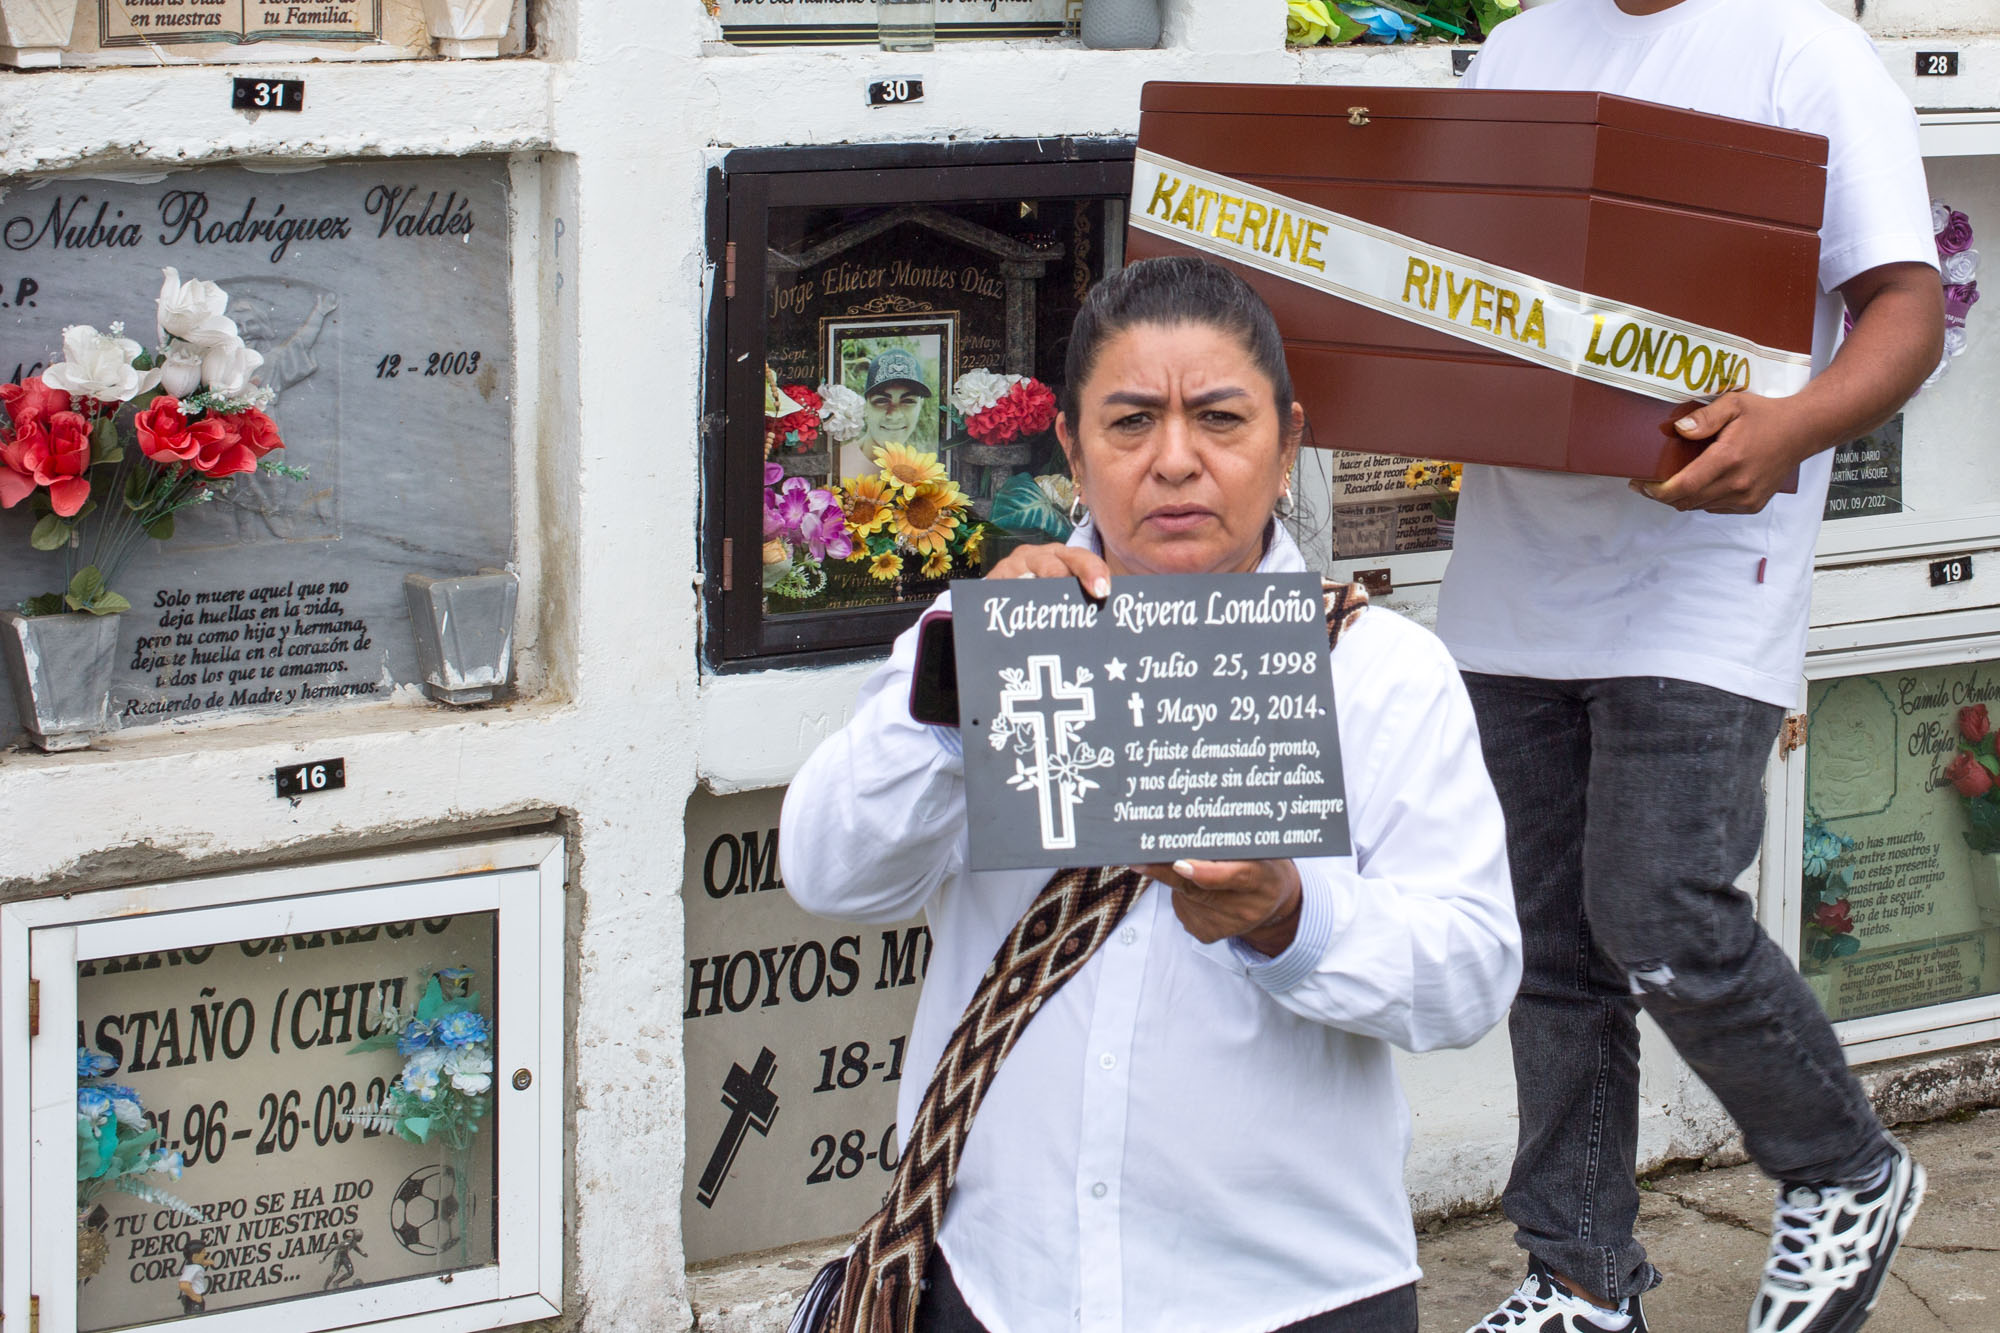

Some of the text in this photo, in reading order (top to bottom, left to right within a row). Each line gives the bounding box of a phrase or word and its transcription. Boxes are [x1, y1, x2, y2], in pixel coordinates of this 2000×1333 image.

[132, 11, 221, 26] en nuestras
[264, 7, 352, 25] tu Familia.
[1928, 55, 1948, 74] 28
[254, 83, 284, 107] 31
[882, 80, 909, 101] 30
[4, 184, 475, 263] Nubia Rodríguez Valdés
[1146, 171, 1329, 273] KATERINE
[1401, 254, 1547, 349] RIVERA
[770, 260, 1004, 318] Jorge Eliécer Montes Díaz
[376, 350, 482, 380] 12 2003
[1339, 459, 1361, 470] hacer
[1364, 456, 1371, 467] el
[1373, 456, 1391, 467] bien
[1367, 471, 1373, 482] y
[1375, 470, 1381, 479] te
[1860, 466, 1888, 480] VÁSQUEZ
[1344, 480, 1383, 495] Recuerdo
[1384, 480, 1395, 491] de
[1396, 480, 1405, 489] tu
[1830, 495, 1886, 511] NOV. 09/2022
[1422, 514, 1434, 523] en
[1942, 562, 1962, 582] 19
[154, 581, 349, 608] Solo muere aquel que no
[159, 597, 344, 630] deja huellas en la vida,
[984, 585, 1316, 638] Katerine Rivera Londoño
[176, 632, 193, 647] tu
[198, 629, 240, 645] como
[243, 621, 276, 643] hija
[280, 626, 290, 641] y
[294, 618, 368, 637] hermana,
[191, 646, 241, 665] huella
[246, 646, 265, 661] en
[269, 640, 284, 659] el
[288, 636, 350, 658] corazón
[353, 635, 373, 652] de
[156, 668, 197, 688] tdos
[202, 667, 224, 685] los
[229, 667, 256, 686] que
[279, 659, 349, 677] amamos.
[1135, 652, 1317, 684] Julio 25, 1998
[123, 681, 379, 717] Recuerdo de Madre y hermanos.
[1898, 677, 1949, 715] Camilo
[1157, 695, 1319, 731] Mayo 29, 2014
[1125, 737, 1321, 768] Te fuiste demasiado pronto,
[296, 765, 327, 791] 16
[1126, 763, 1325, 797] y nos dejaste sin decir adios.
[1114, 795, 1344, 823] Nunca te olvidaremos, y siempre
[1141, 827, 1323, 850] te recordaremos con amor.
[1866, 830, 1926, 850] has muerto,
[703, 828, 785, 900] OM
[1859, 852, 1886, 865] entre
[1888, 844, 1930, 860] nosotros
[1932, 843, 1940, 857] y
[1852, 870, 1865, 881] no
[1894, 857, 1940, 879] presente,
[1897, 875, 1906, 888] el
[1908, 870, 1945, 886] camino
[1867, 908, 1880, 921] de
[1882, 905, 1903, 919] tus
[1901, 900, 1925, 920] hijos
[1927, 901, 1935, 915] y
[1876, 892, 1888, 905] de
[1859, 923, 1893, 938] nietos.
[683, 934, 862, 1020] HOYOS
[1894, 967, 1914, 981] Dios
[114, 1179, 374, 1238] TU CUERPO SE HA IDO
[128, 1204, 359, 1260] PERO EN NUESTROS
[130, 1242, 271, 1284] CORONES
[178, 1264, 301, 1300] ORIRAS...
